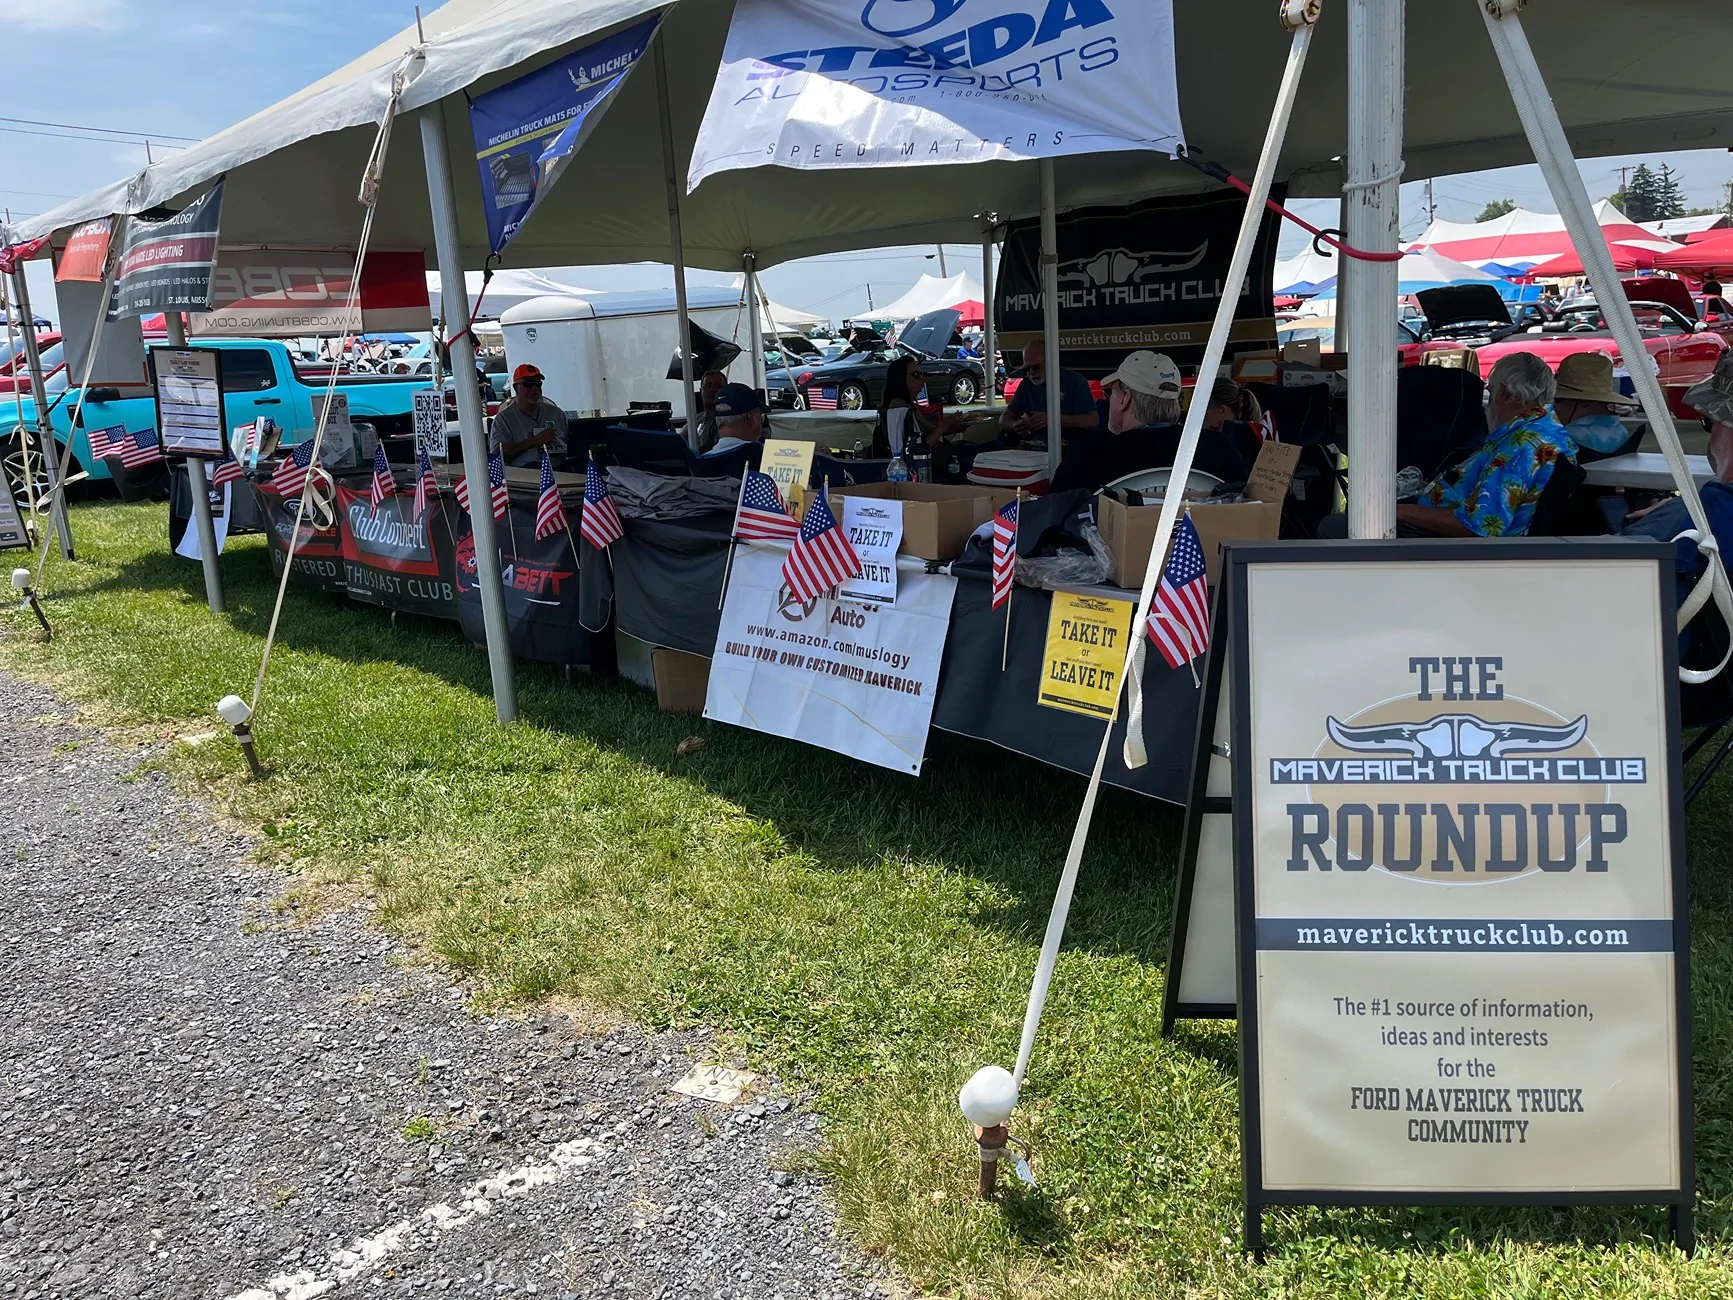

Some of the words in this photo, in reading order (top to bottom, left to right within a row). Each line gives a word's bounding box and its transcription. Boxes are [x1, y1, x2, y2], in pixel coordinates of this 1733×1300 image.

[746, 0, 1115, 81] STEEDA
[733, 36, 1119, 106] AUOSPORTS
[488, 126, 520, 147] MICHELIN
[520, 118, 544, 137] TRUCK
[544, 110, 566, 126] MATS
[566, 105, 583, 118] FOR
[766, 142, 867, 158] SPEED
[900, 131, 1063, 156] MATTERS
[155, 244, 184, 261] LIGHTING
[1005, 287, 1097, 312] MAVRICK
[1101, 282, 1176, 305] TRUCK
[1059, 330, 1192, 346] avericktruckclub.com
[767, 467, 791, 483] TAKE
[791, 468, 803, 483] IT
[850, 527, 879, 546] TAKE
[879, 531, 893, 547] IT
[343, 561, 401, 595] THUSIAST
[407, 579, 454, 602] CLUB
[852, 564, 878, 582] AVE
[879, 566, 890, 584] IT
[830, 605, 866, 629] Auto
[1061, 619, 1100, 646] TAKE
[1101, 626, 1117, 648] IT
[746, 624, 911, 670] www.amazon.com/muslogy
[1081, 648, 1090, 657] or
[725, 641, 750, 656] BUILD
[751, 646, 777, 662] YOUR
[780, 651, 805, 668] OWN
[806, 656, 864, 682] CUSTOMIZED
[864, 670, 923, 696] MAVERICK
[1050, 660, 1097, 688] LEAVE
[1098, 669, 1115, 691] IT
[1408, 656, 1504, 701] THE
[1273, 759, 1435, 781] MAVERICK
[1441, 759, 1549, 781] TRUCK
[1556, 758, 1644, 781] CLUB
[1286, 803, 1628, 873] ROUNDUP
[1297, 922, 1630, 947] mavericktruckclub.com
[1333, 997, 1367, 1017] The
[1370, 998, 1391, 1017] #1
[1396, 1001, 1455, 1018] source
[1459, 998, 1479, 1018] of
[1482, 998, 1595, 1021] information,
[1381, 1026, 1428, 1046] ideas
[1432, 1027, 1465, 1047] and
[1470, 1027, 1549, 1047] interests
[1437, 1057, 1462, 1077] for
[1466, 1058, 1496, 1078] the
[1350, 1086, 1401, 1112] FORD
[1405, 1087, 1513, 1113] MAVERICK
[1516, 1088, 1585, 1114] TRUCK
[1407, 1118, 1530, 1144] COMMUNITY
